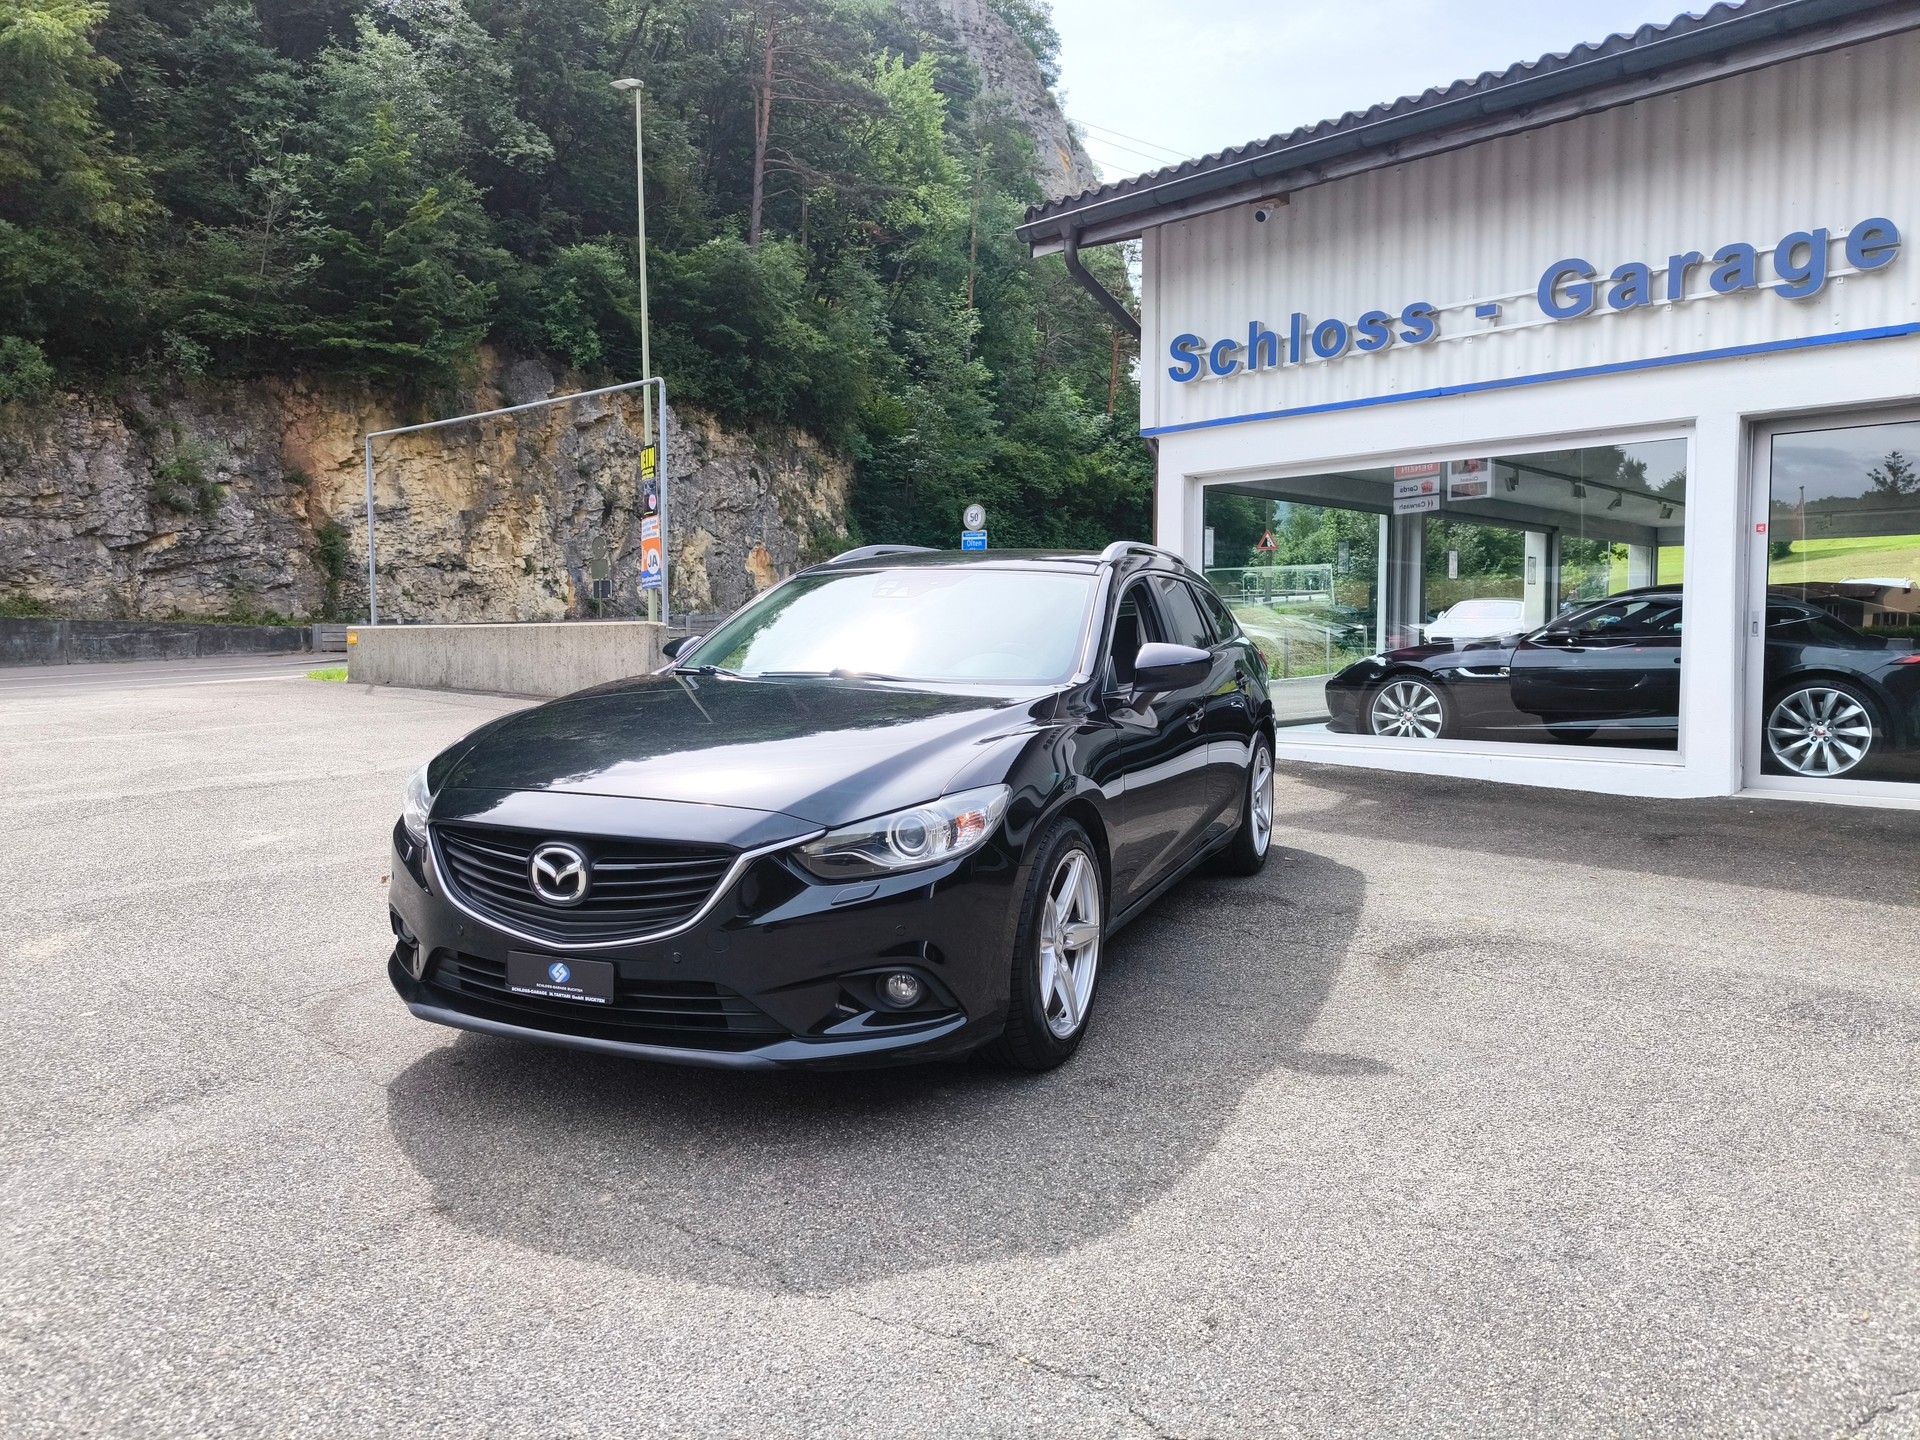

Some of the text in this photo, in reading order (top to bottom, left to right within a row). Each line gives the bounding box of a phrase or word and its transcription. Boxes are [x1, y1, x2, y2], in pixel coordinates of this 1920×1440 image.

[1168, 302, 1440, 384] Schloss
[1537, 217, 1901, 322] Garage
[969, 512, 979, 522] 50
[648, 554, 659, 568] JA
